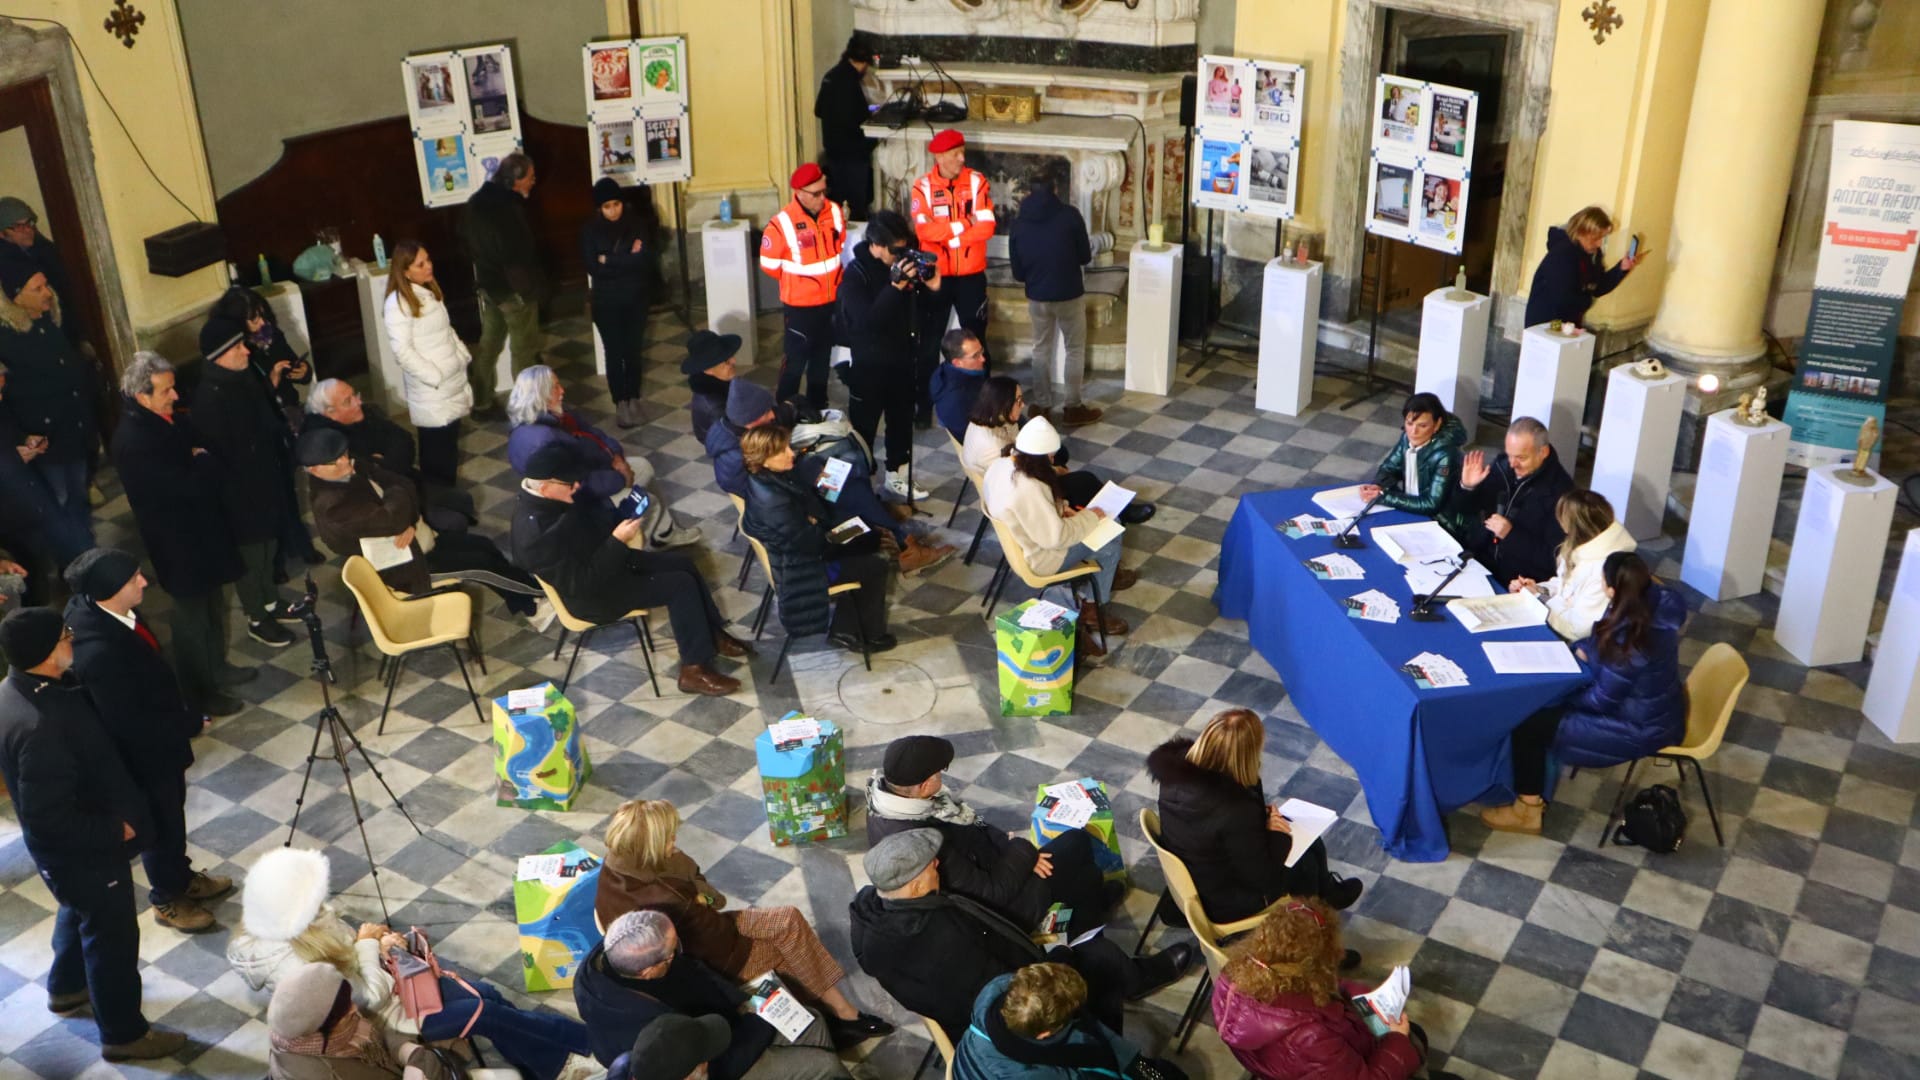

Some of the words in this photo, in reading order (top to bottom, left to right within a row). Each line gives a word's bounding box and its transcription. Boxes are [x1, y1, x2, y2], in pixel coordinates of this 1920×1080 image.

[1857, 175, 1895, 191] MUSEO
[1832, 188, 1880, 207] ANTICHI
[1881, 192, 1920, 211] RIFIUT
[1881, 209, 1914, 224] MARE
